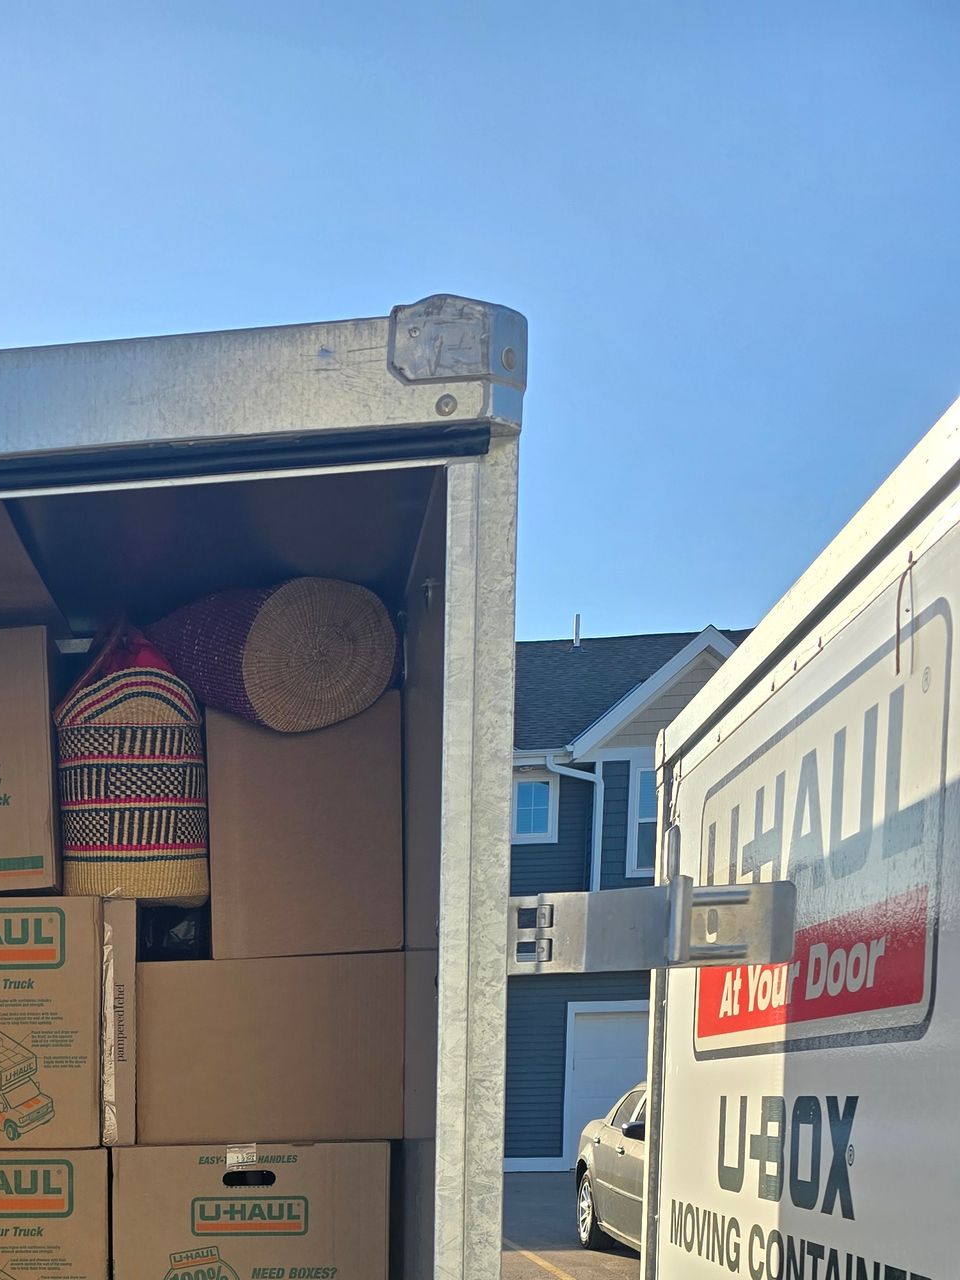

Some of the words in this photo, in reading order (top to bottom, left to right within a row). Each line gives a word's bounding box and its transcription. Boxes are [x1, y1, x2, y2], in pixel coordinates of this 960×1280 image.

[3, 977, 34, 990] Truck
[720, 964, 742, 1019] At
[748, 960, 797, 1017] Your
[806, 935, 886, 1002] Door
[258, 1155, 298, 1164] HANDLES
[718, 1095, 859, 1220] U-BOX
[199, 1203, 301, 1221] U-HAUL
[13, 1226, 43, 1237] Truck
[670, 1199, 740, 1274] MOVING
[173, 1250, 216, 1263] U-HAUL
[251, 1268, 285, 1279] NEED
[289, 1268, 337, 1279] BOXES?
